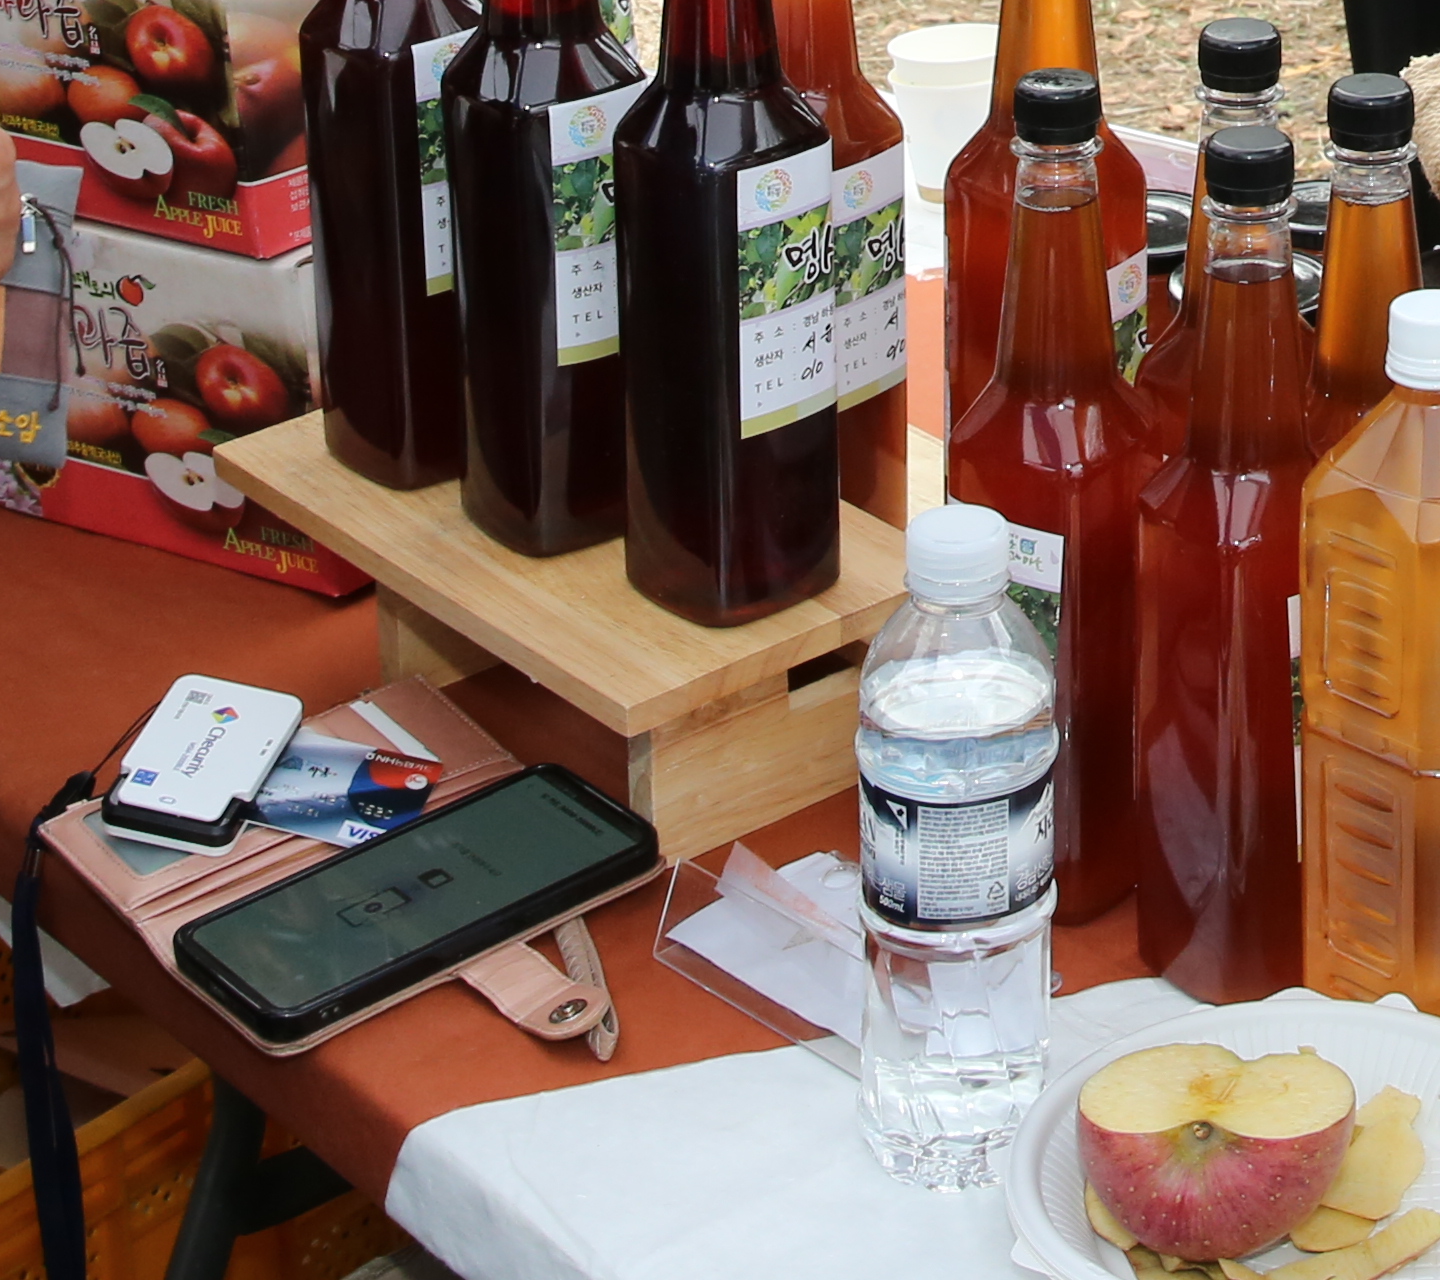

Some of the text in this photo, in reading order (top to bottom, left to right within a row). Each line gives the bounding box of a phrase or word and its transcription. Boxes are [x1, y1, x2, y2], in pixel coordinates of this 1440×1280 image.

[187, 190, 240, 216] FRESH
[572, 282, 604, 300] 생산자
[803, 307, 821, 329] 경남
[754, 351, 784, 369] 생산자
[179, 725, 227, 779] Checurity
[348, 825, 388, 842] VIS
